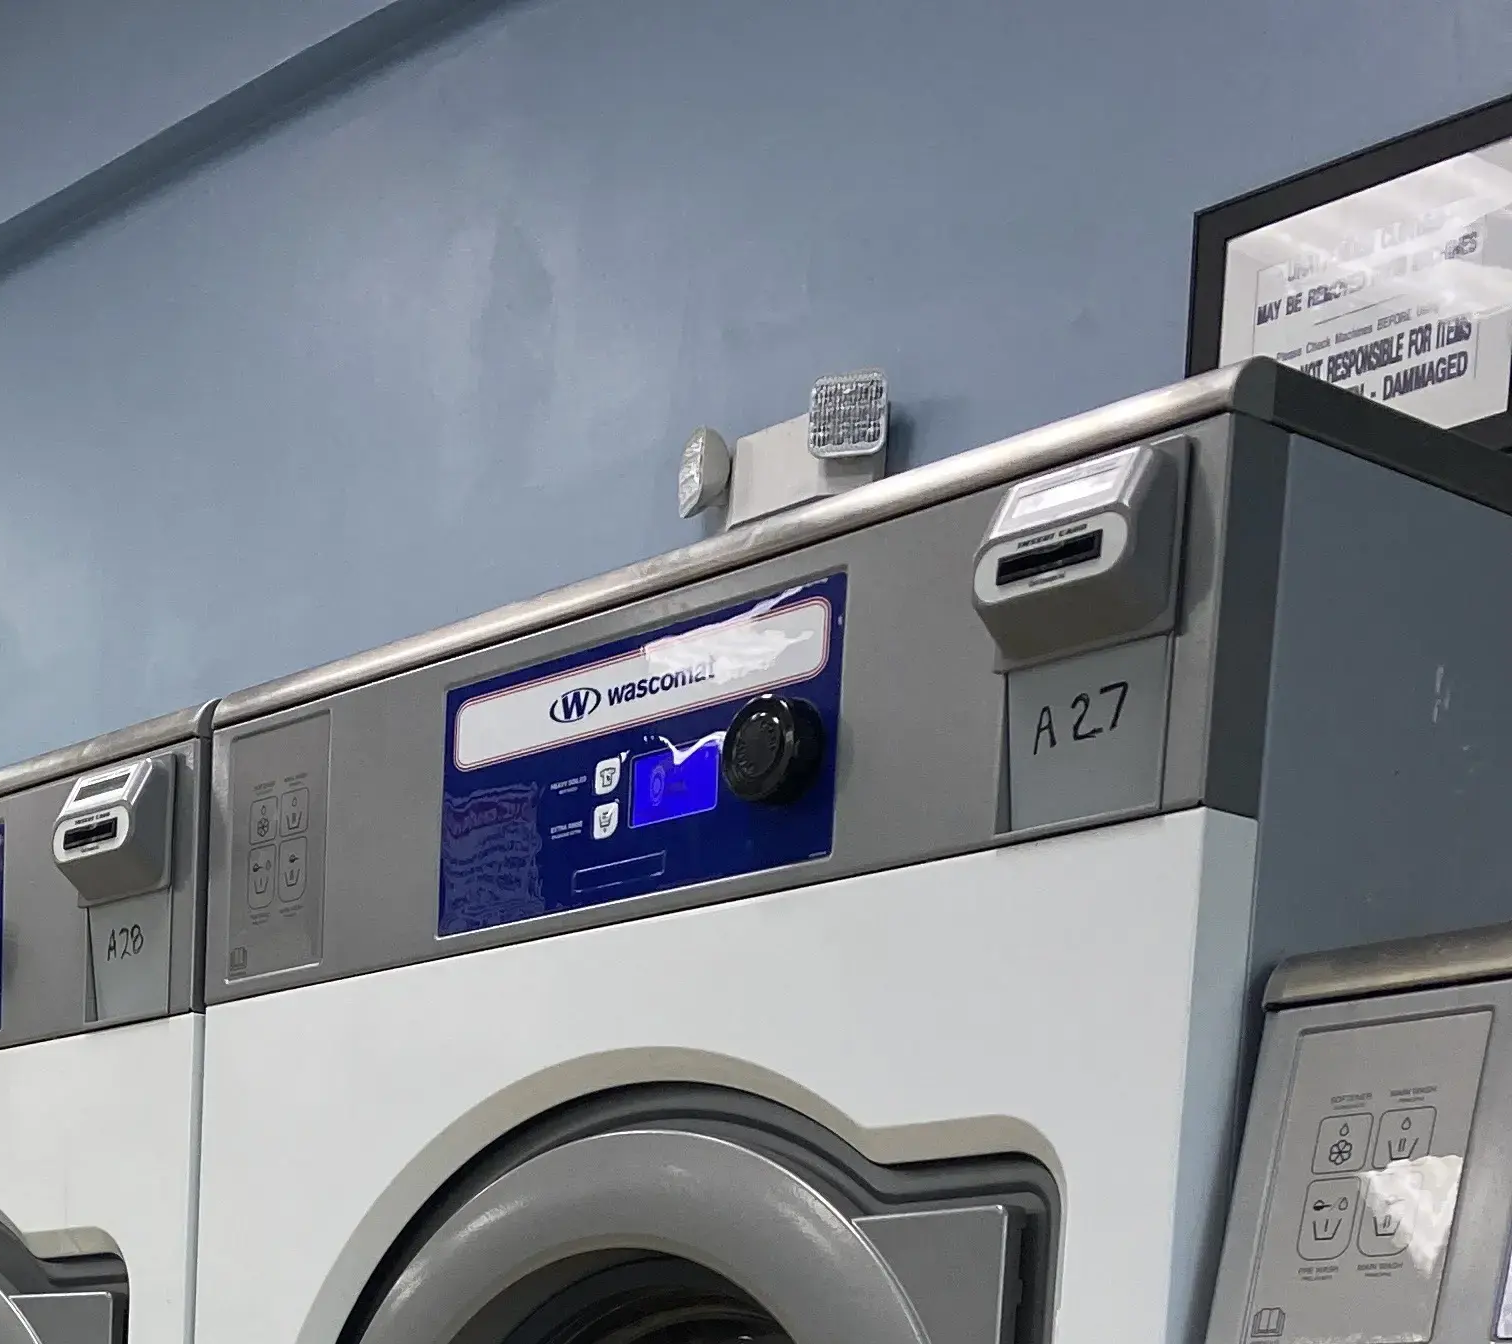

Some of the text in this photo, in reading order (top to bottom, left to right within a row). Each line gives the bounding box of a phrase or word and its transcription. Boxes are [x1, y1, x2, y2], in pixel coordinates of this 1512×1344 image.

[1257, 299, 1283, 325] MAY
[1286, 292, 1303, 315] BE
[1327, 332, 1404, 384] RESPONSIBLE
[1408, 323, 1432, 359] FOR
[1436, 317, 1472, 349] ITEMS
[1382, 351, 1468, 401] DAMMAGED
[607, 654, 715, 706] wascomat
[1033, 681, 1129, 756] A27
[107, 923, 144, 962] A28
